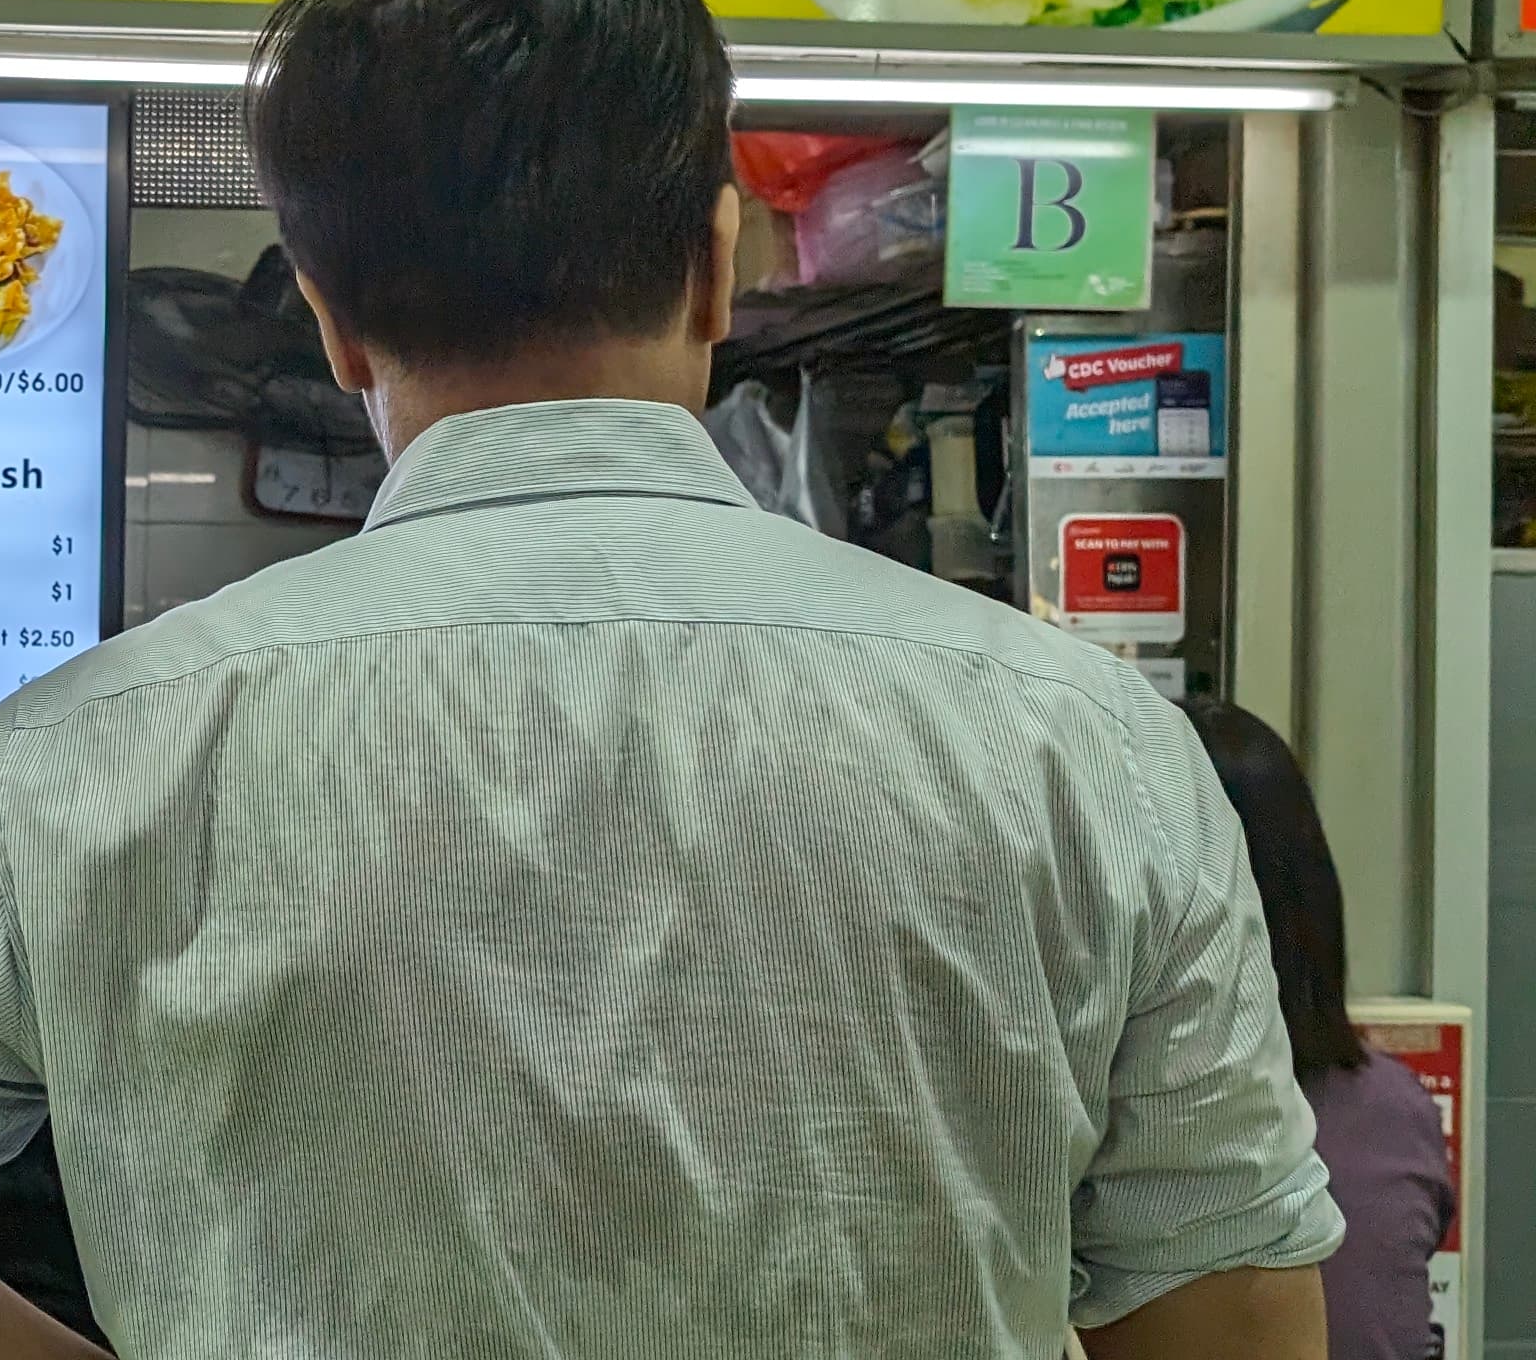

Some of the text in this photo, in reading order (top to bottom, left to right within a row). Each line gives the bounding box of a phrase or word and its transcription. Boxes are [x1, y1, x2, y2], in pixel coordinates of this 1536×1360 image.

[1010, 158, 1087, 252] B
[1068, 352, 1174, 379] CDC Voucher
[1066, 392, 1150, 421] Accepted
[51, 536, 73, 556] $1
[50, 583, 73, 603] $1
[19, 629, 75, 648] $2.50
